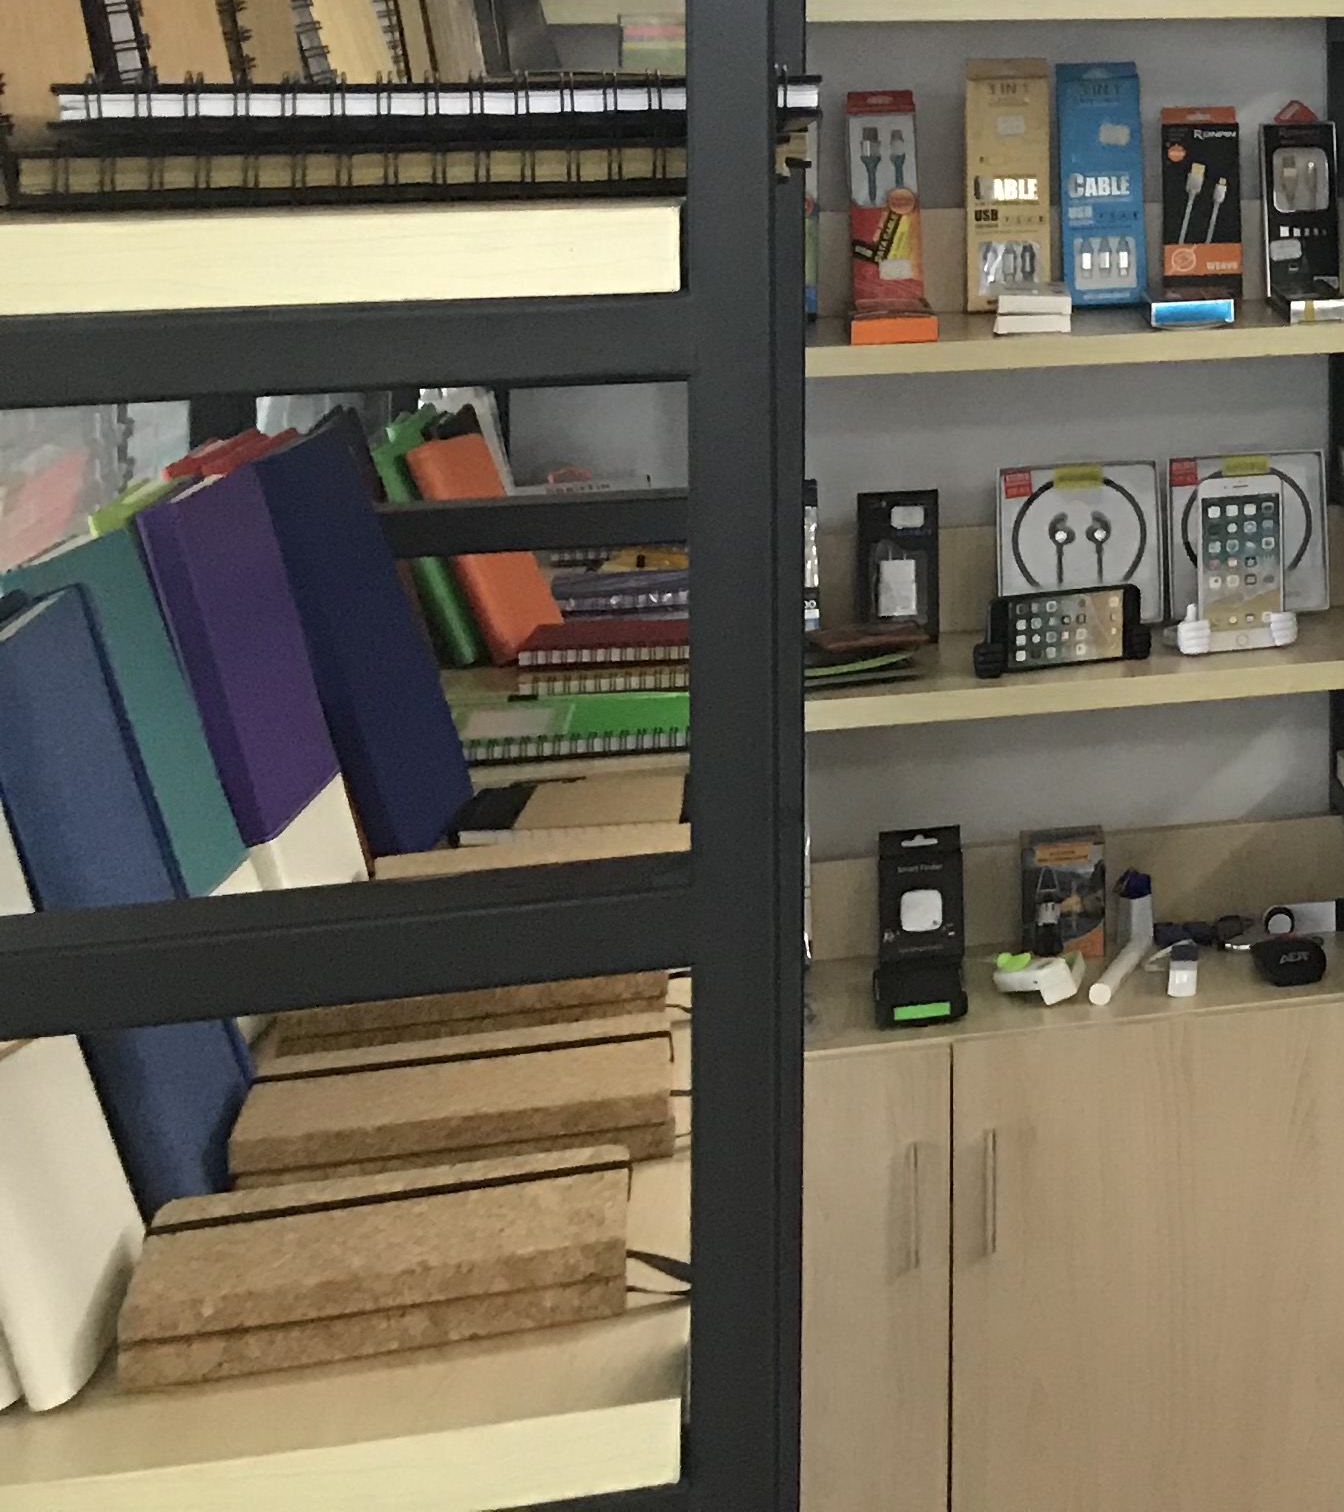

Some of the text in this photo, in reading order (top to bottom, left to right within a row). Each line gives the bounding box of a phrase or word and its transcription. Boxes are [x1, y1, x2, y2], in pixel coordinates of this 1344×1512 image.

[974, 176, 1039, 201] CABLE
[1068, 173, 1130, 198] CABLE
[974, 209, 999, 222] USB
